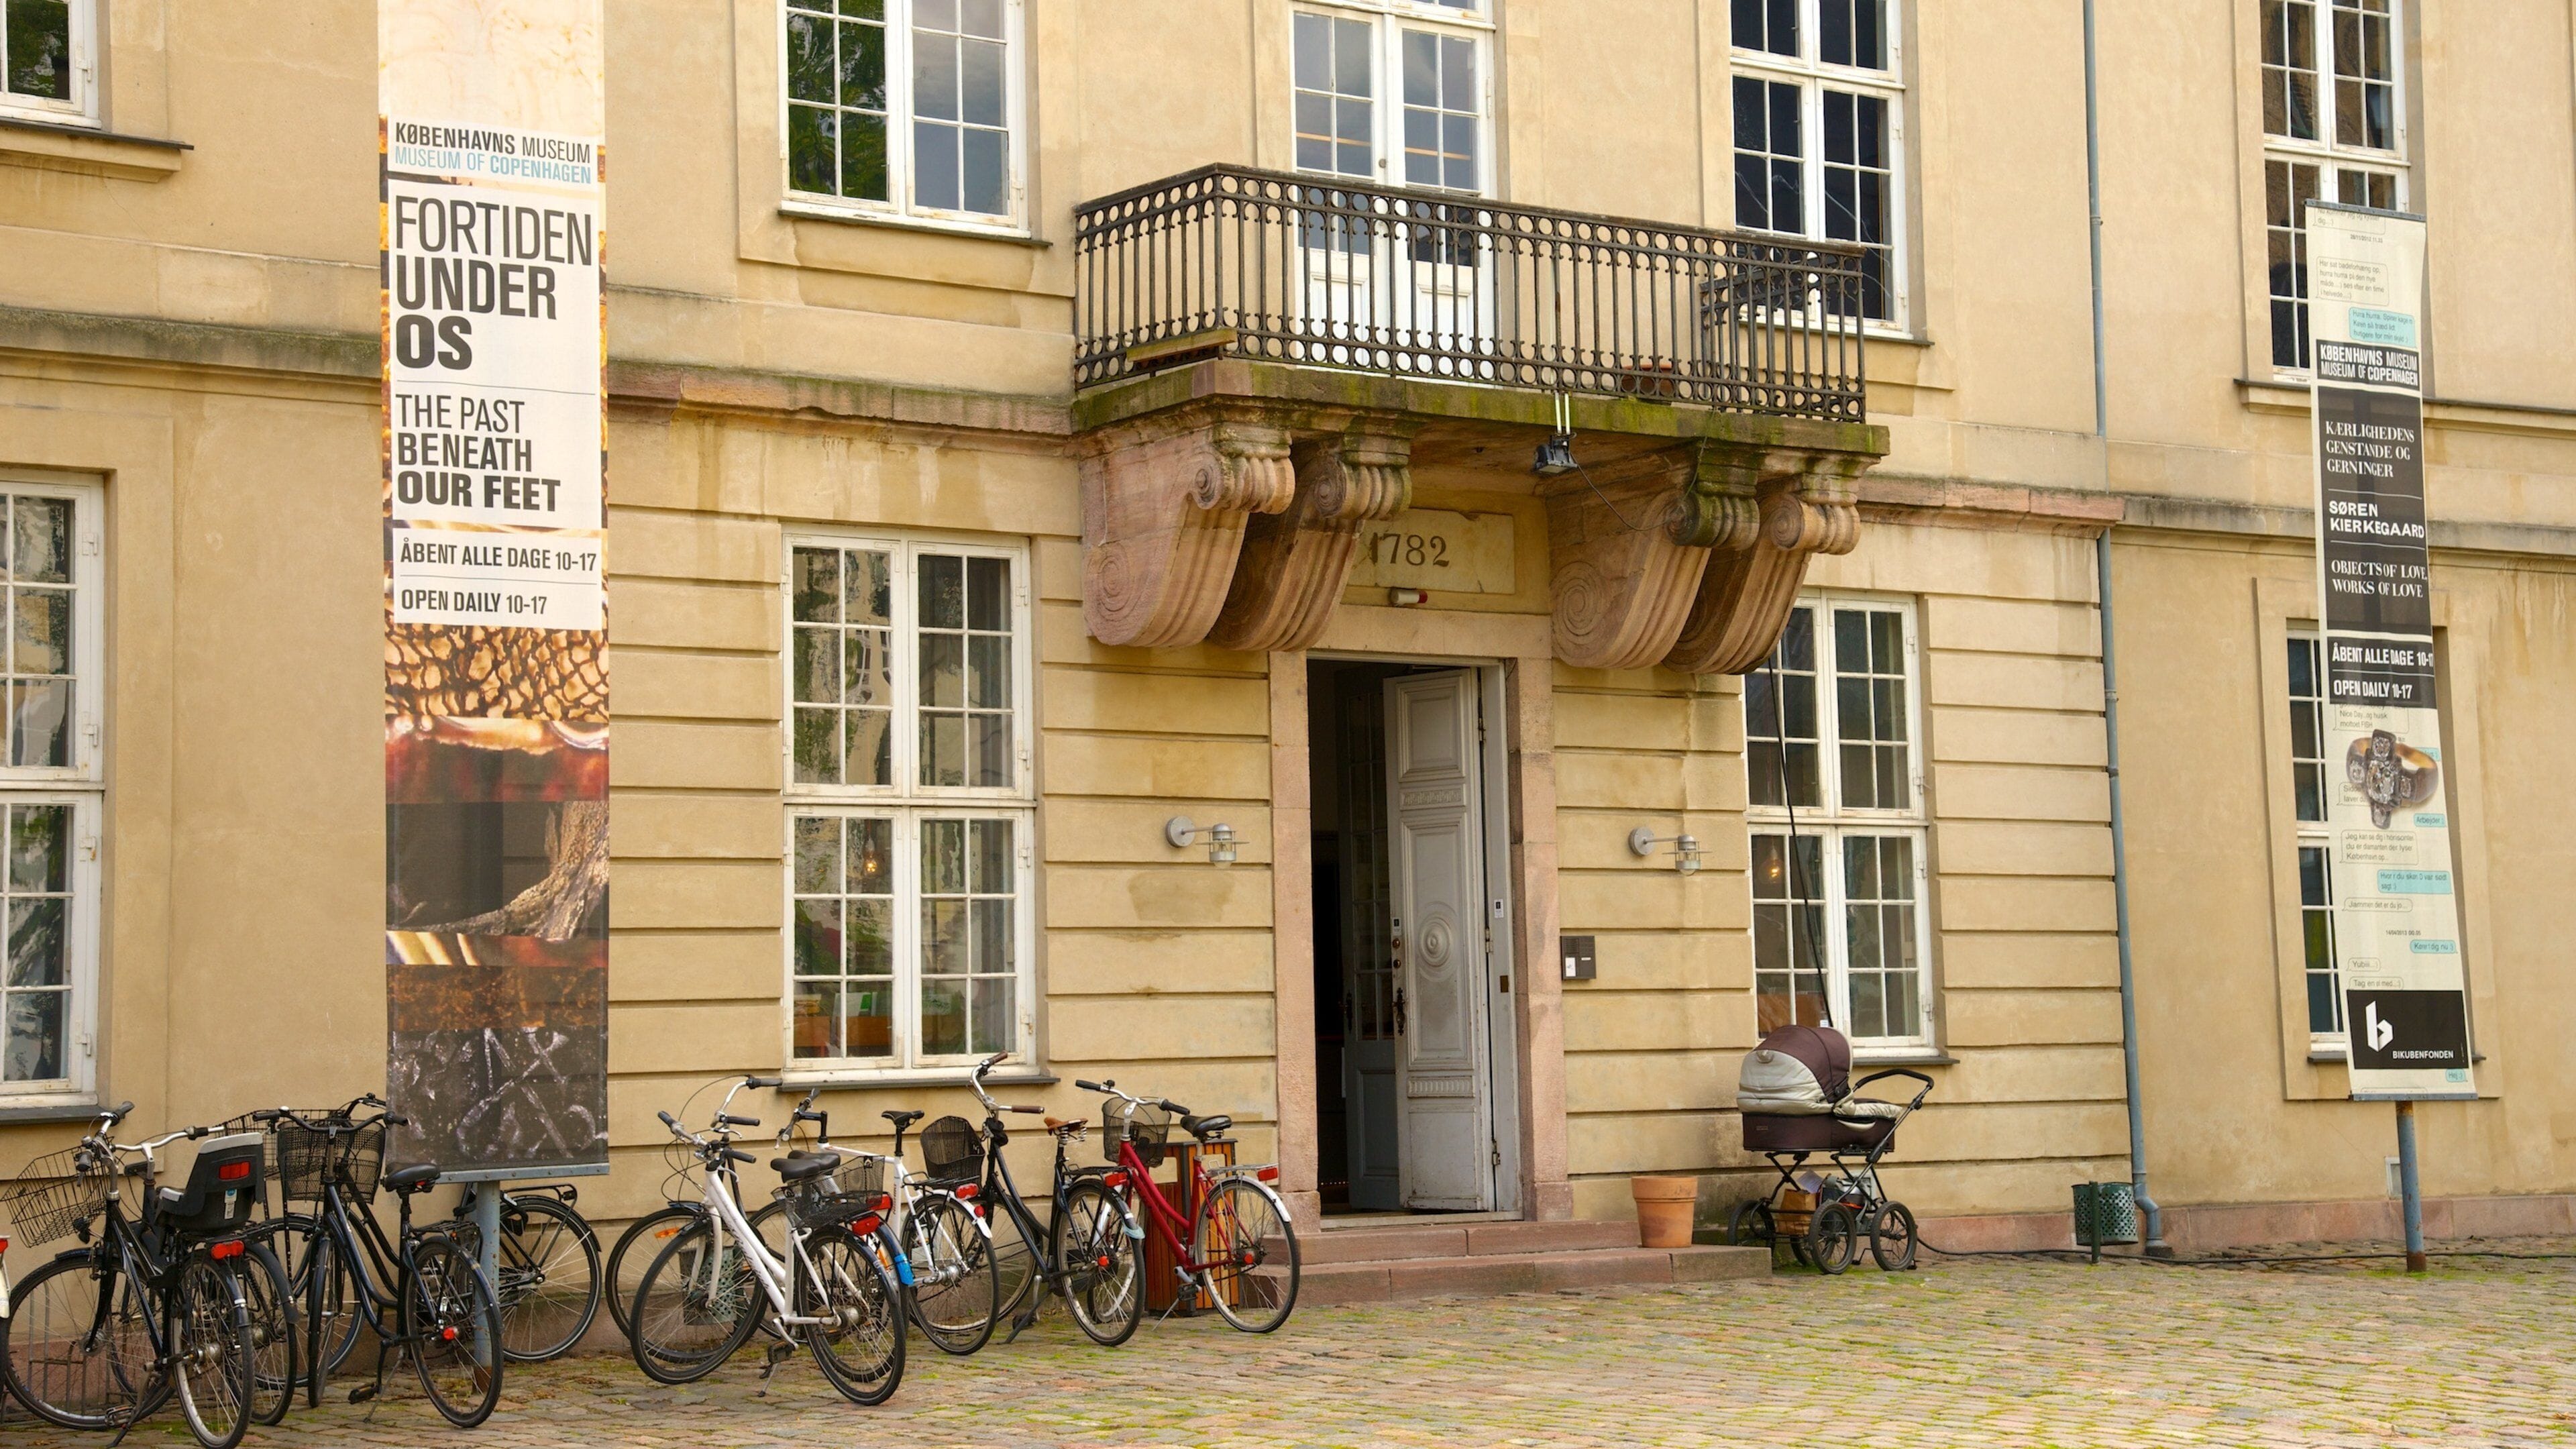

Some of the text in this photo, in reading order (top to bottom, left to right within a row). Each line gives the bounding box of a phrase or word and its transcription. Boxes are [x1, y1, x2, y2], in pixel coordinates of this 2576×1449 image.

[396, 122, 590, 163] KØBENHAVNS MUSEUM
[395, 146, 591, 184] MUSEUM OF COPENHAGEN
[396, 195, 592, 266] FORTIDEN
[396, 255, 557, 320] UNDER
[396, 314, 472, 370] OS
[2320, 344, 2418, 370] KØBENHAVNS MUSEUM
[2321, 361, 2418, 386] MUSEUM OF COPENHAGEN
[396, 394, 525, 433] THE PAST
[2325, 421, 2415, 443] KÆRLIGHEDENS
[397, 433, 532, 472] BENEATH
[2326, 440, 2410, 460] GENSTANDE OG
[2326, 459, 2394, 478] GERNINGER
[397, 471, 561, 511] OUR FEET
[2329, 500, 2378, 517] SØREN
[2330, 517, 2424, 539] KIERKEGAARD
[400, 537, 596, 571] ÅBENT ALLE DAGE 10-17
[1369, 532, 1449, 567] 1782
[2331, 559, 2381, 576] OBJECTS
[2383, 564, 2397, 578] OF
[2332, 578, 2423, 598] WORKS OF LOVE
[402, 589, 547, 614] OPEN DAILY 10-17
[2332, 642, 2363, 662] ÅBENT
[2365, 648, 2389, 664] ALLE
[2390, 649, 2414, 665] DAGE
[2333, 680, 2412, 699] OPEN DAILY 10-17
[2353, 979, 2366, 988] Tag
[2392, 1051, 2454, 1059] BIKUBENFONDEN
